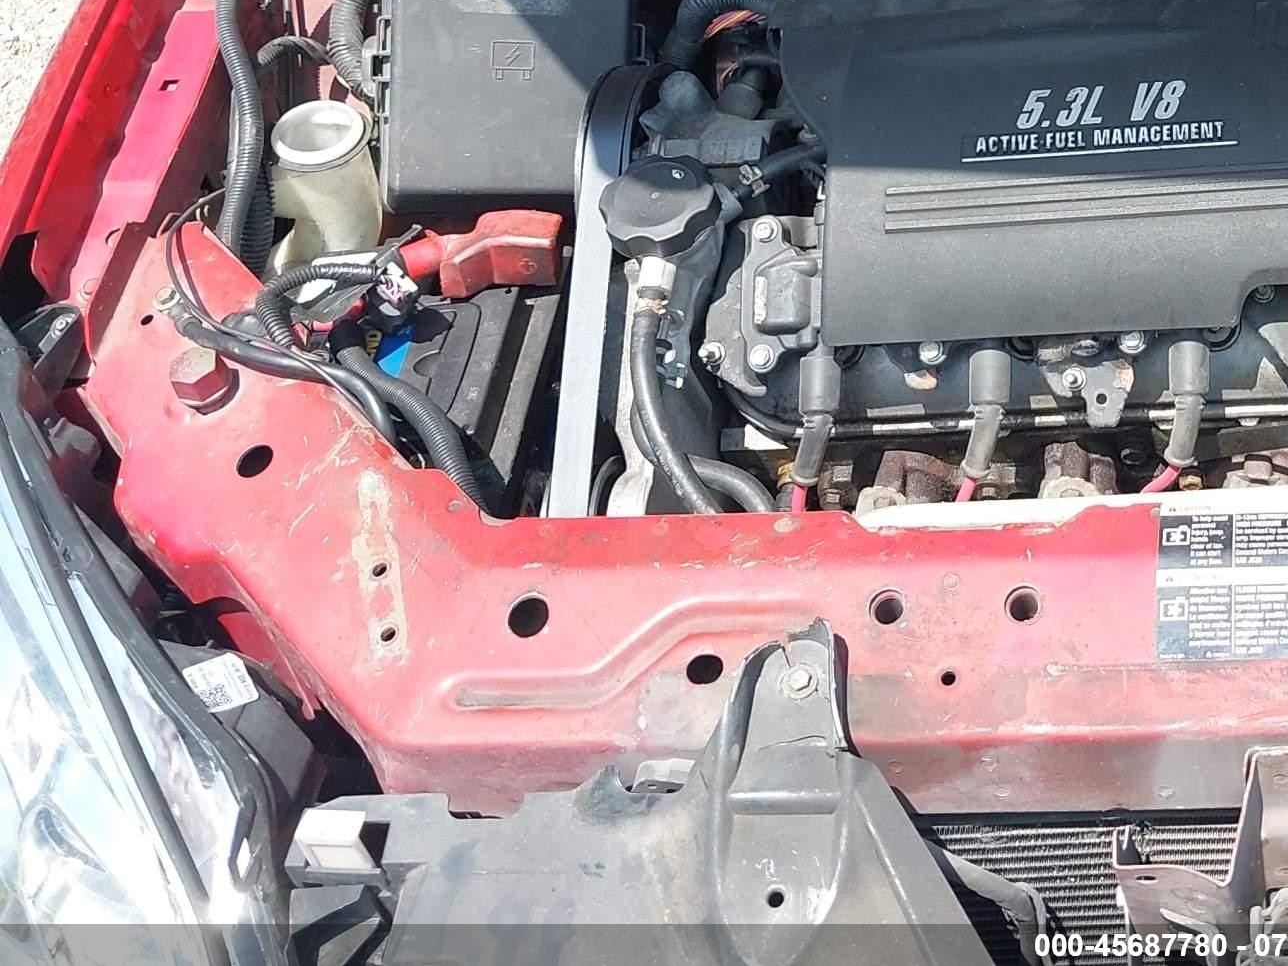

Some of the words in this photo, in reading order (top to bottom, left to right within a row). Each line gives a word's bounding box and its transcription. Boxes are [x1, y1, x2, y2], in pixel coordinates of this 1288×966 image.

[1016, 86, 1104, 129] 5.3L
[1130, 80, 1186, 122] V8
[976, 135, 1038, 154] ACTIVE
[1046, 131, 1086, 149] FUEL
[1093, 121, 1224, 146] MANAGEMENT
